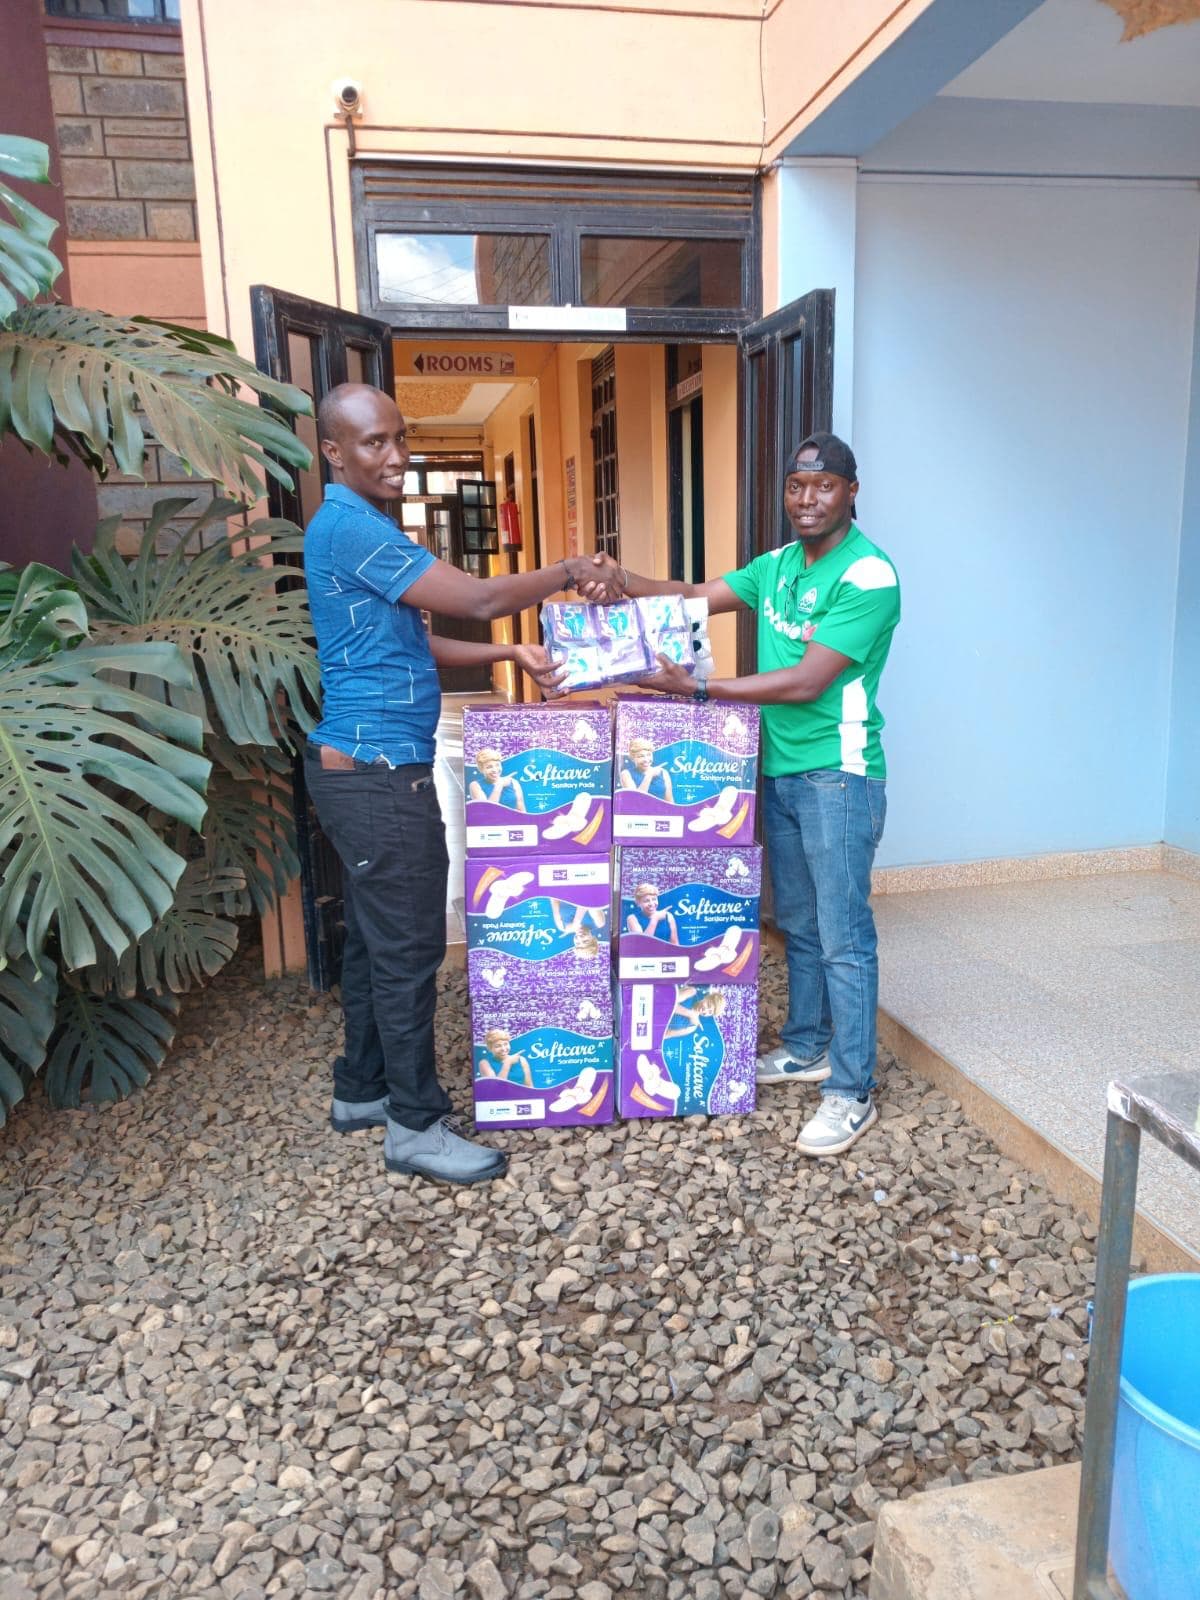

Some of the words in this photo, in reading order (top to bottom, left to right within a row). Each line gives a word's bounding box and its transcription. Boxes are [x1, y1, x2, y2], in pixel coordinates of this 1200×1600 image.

[427, 355, 493, 371] ROOMS
[520, 764, 591, 787] Softcare
[670, 755, 739, 778] Softcare
[700, 774, 725, 782] Sanitary
[674, 898, 743, 920] Softcare
[704, 915, 729, 923] Sanitary
[486, 924, 557, 946] Softcare
[527, 1041, 596, 1063] Softcare
[684, 1062, 692, 1085] Sanitary
[688, 1033, 710, 1098] Softcare
